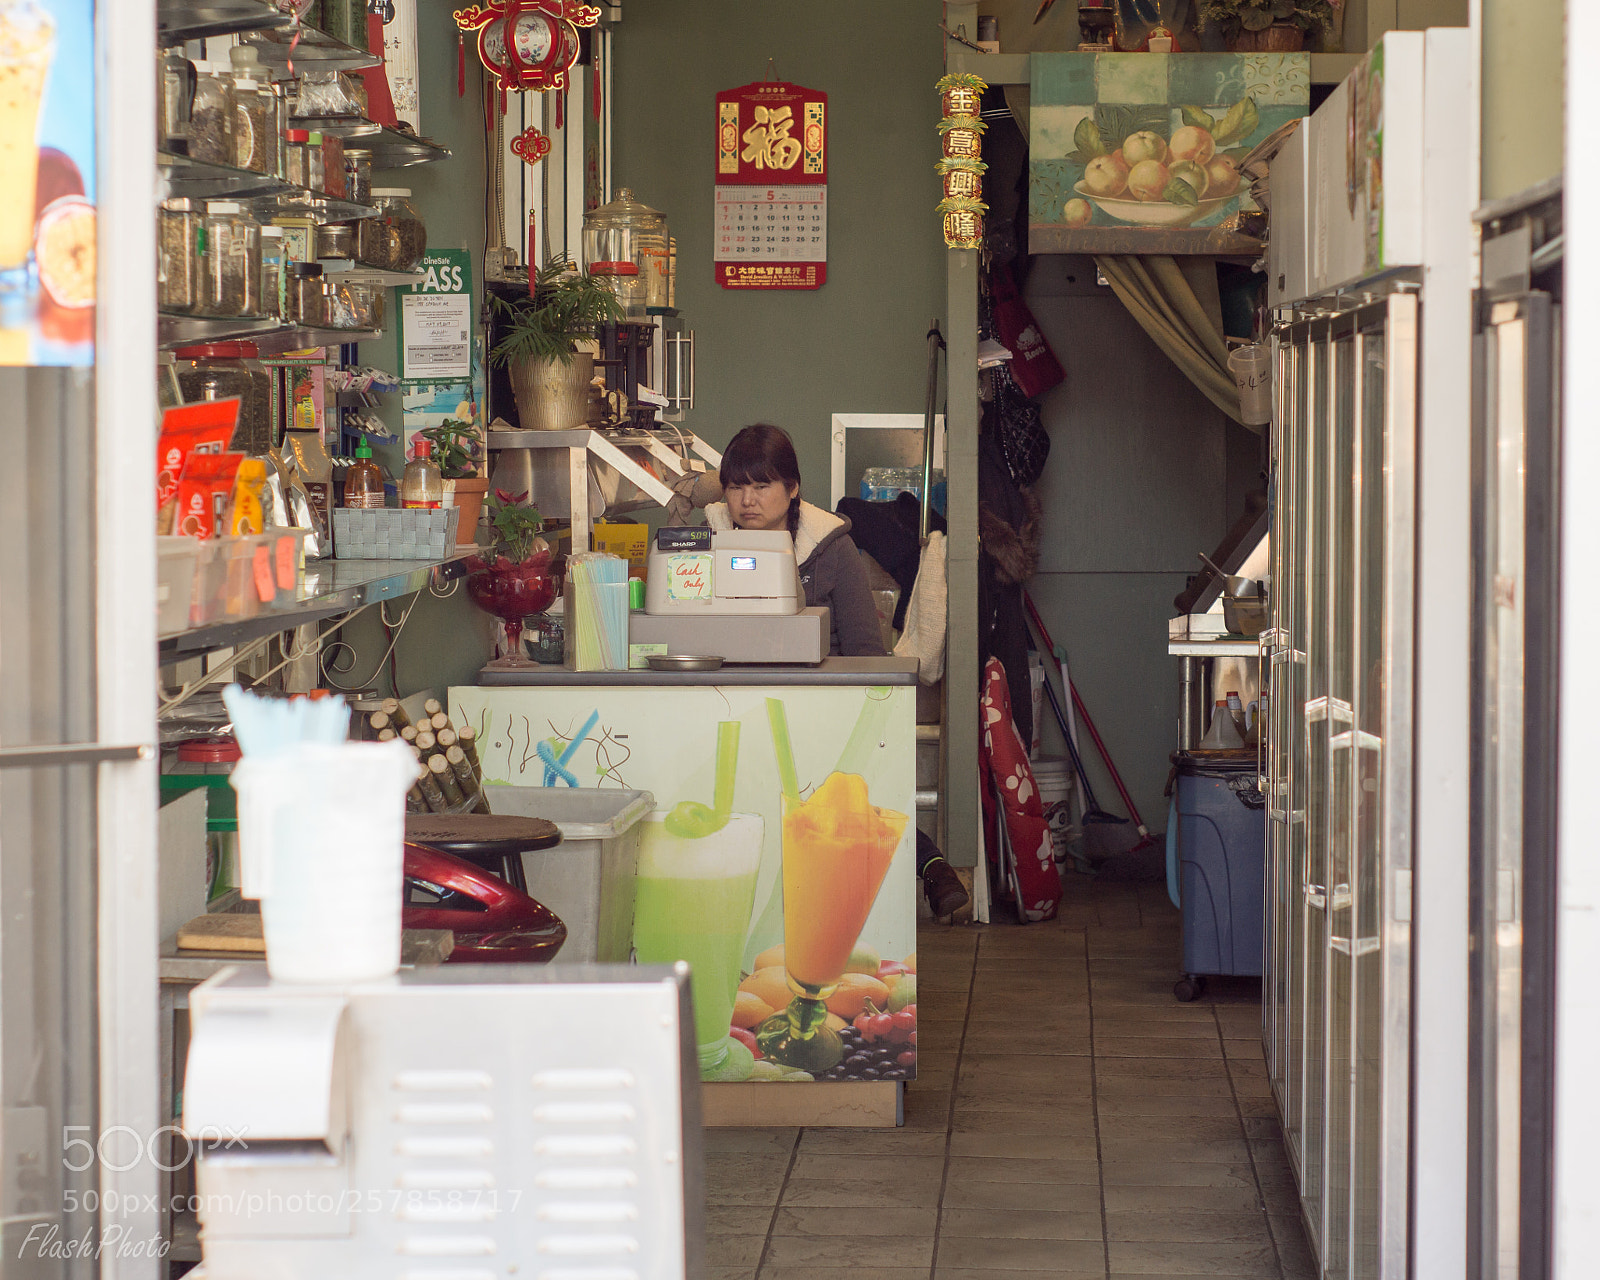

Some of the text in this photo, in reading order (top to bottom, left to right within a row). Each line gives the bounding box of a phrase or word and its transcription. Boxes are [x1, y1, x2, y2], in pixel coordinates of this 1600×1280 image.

[741, 105, 802, 170] 福
[766, 190, 775, 200] 5
[423, 256, 451, 265] DineSafe
[676, 563, 702, 576] Cash
[684, 578, 704, 596] only
